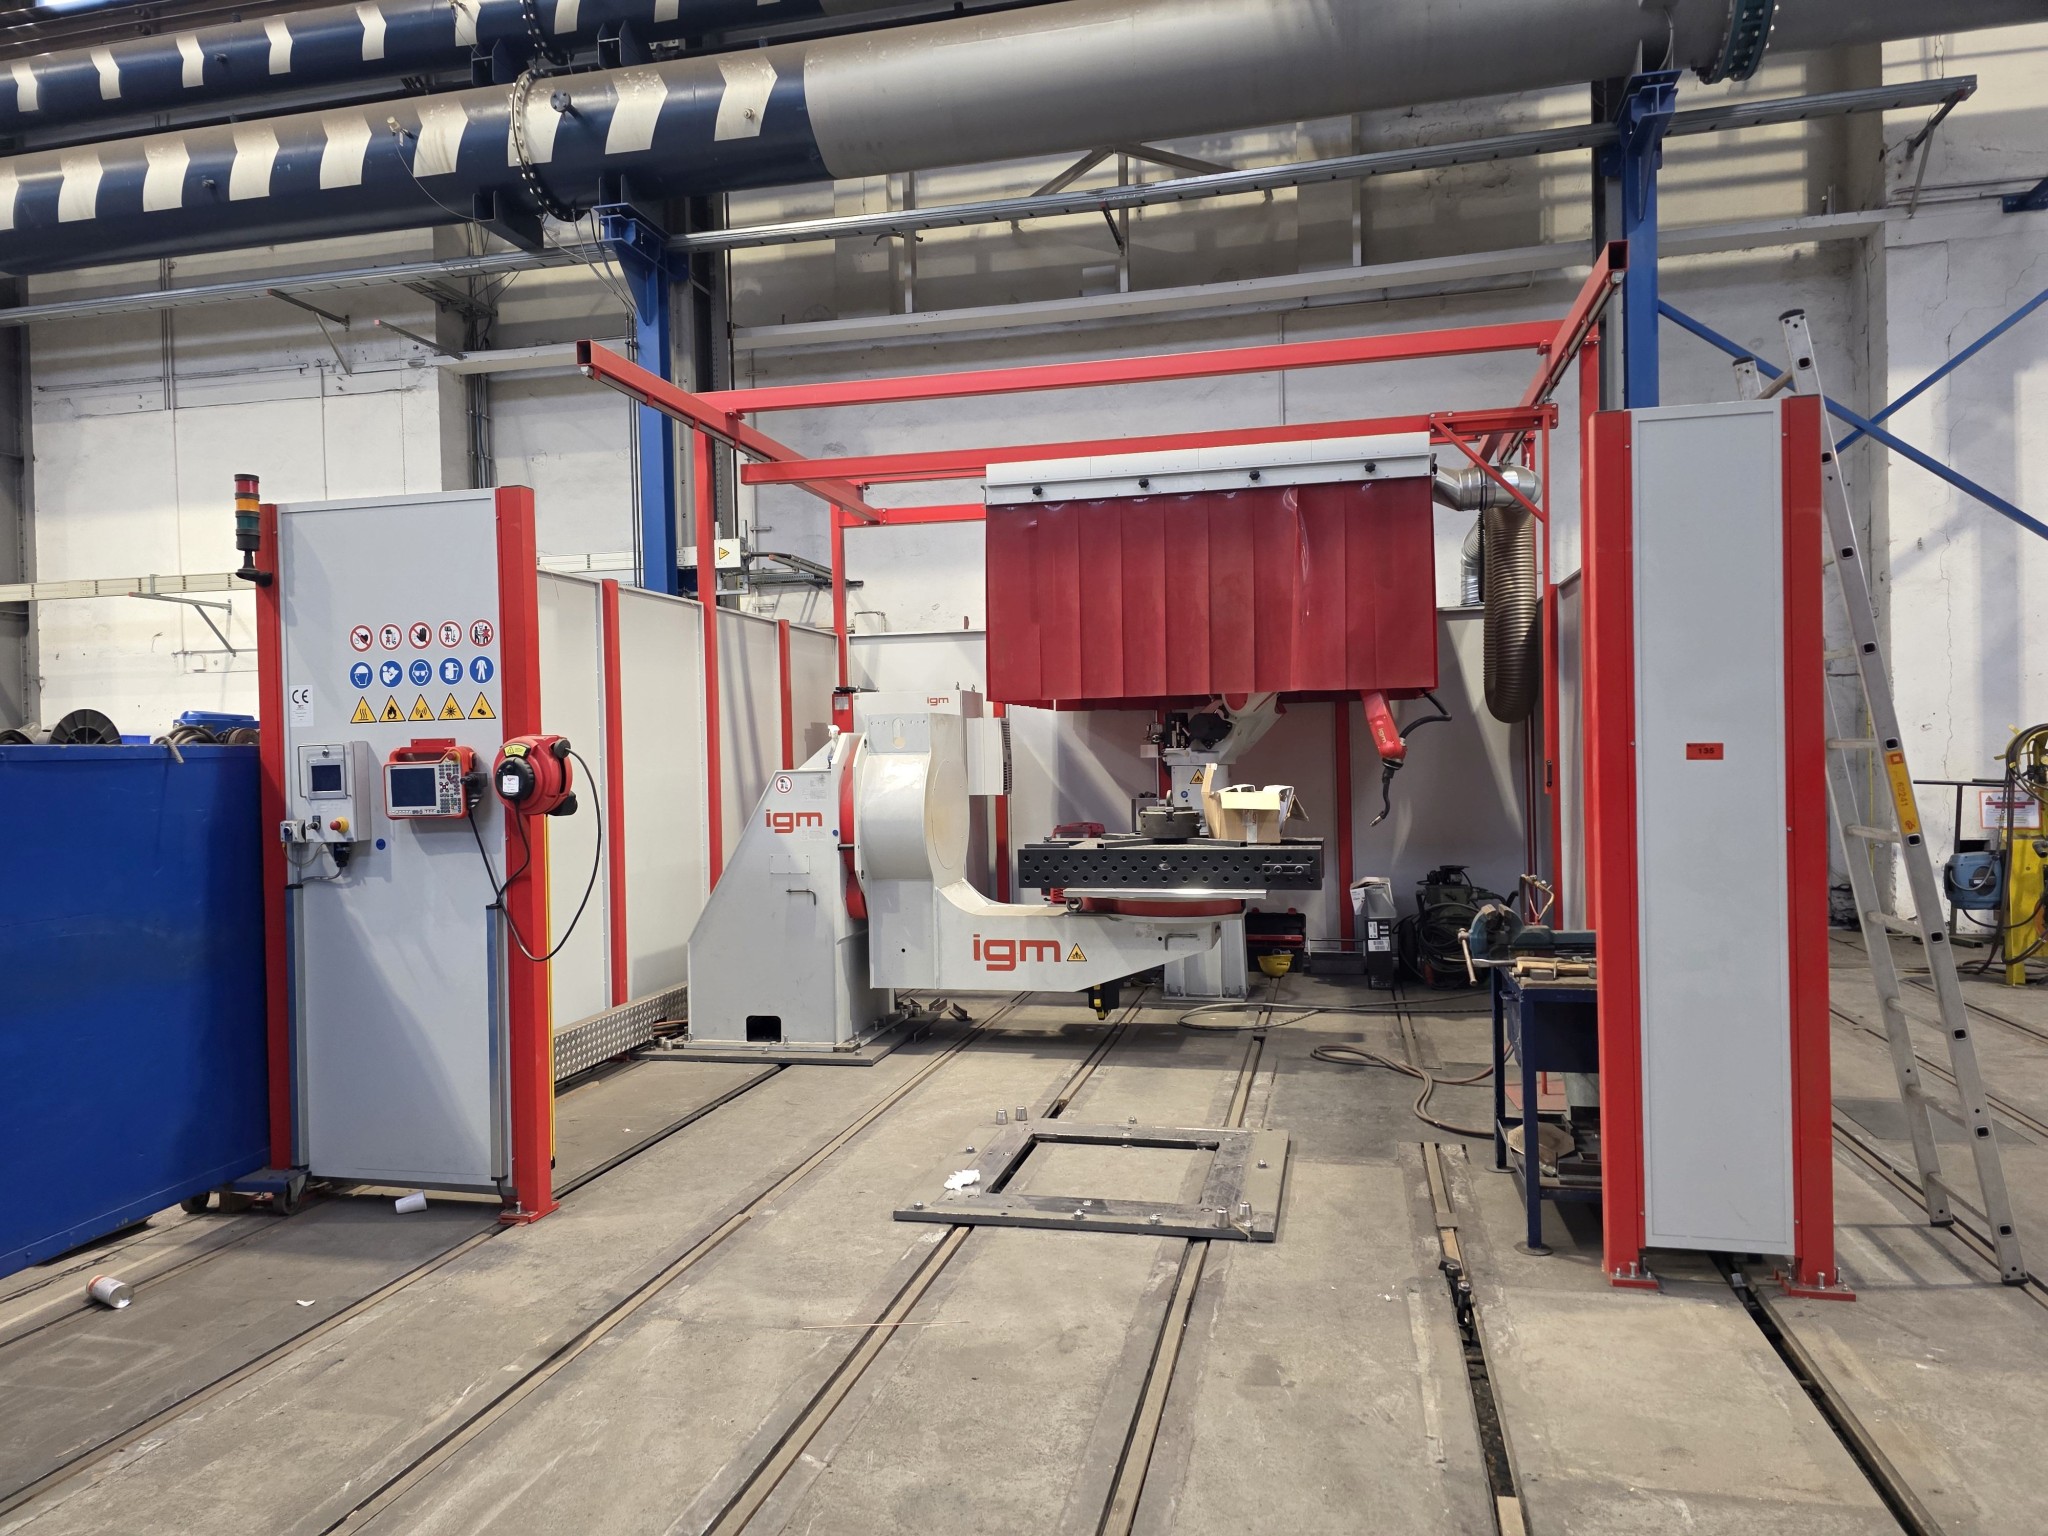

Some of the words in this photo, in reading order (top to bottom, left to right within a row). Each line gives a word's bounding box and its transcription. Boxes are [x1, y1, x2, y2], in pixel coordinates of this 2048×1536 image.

[926, 696, 949, 706] igm
[765, 808, 823, 834] igm
[973, 933, 1061, 971] igm
